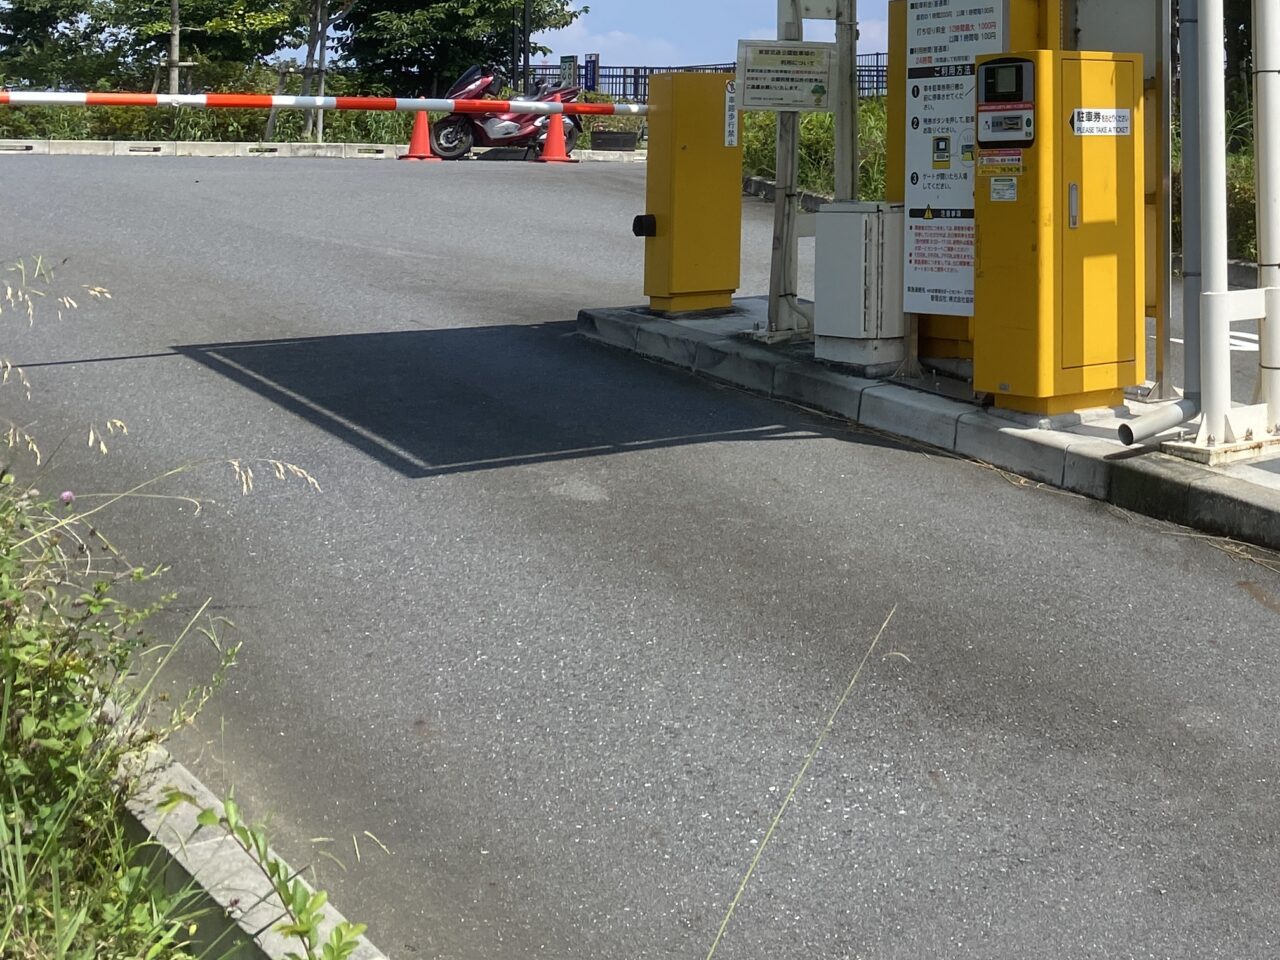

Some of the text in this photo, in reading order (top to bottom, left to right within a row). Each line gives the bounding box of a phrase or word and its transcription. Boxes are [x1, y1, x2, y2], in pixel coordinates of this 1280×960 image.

[916, 25, 946, 37] 打ち切り料金
[981, 31, 997, 41] 100円
[934, 65, 971, 77] ご利用方法
[1076, 126, 1095, 134] PLEASE
[1096, 126, 1108, 134] TAKE
[1113, 126, 1129, 134] TICKET
